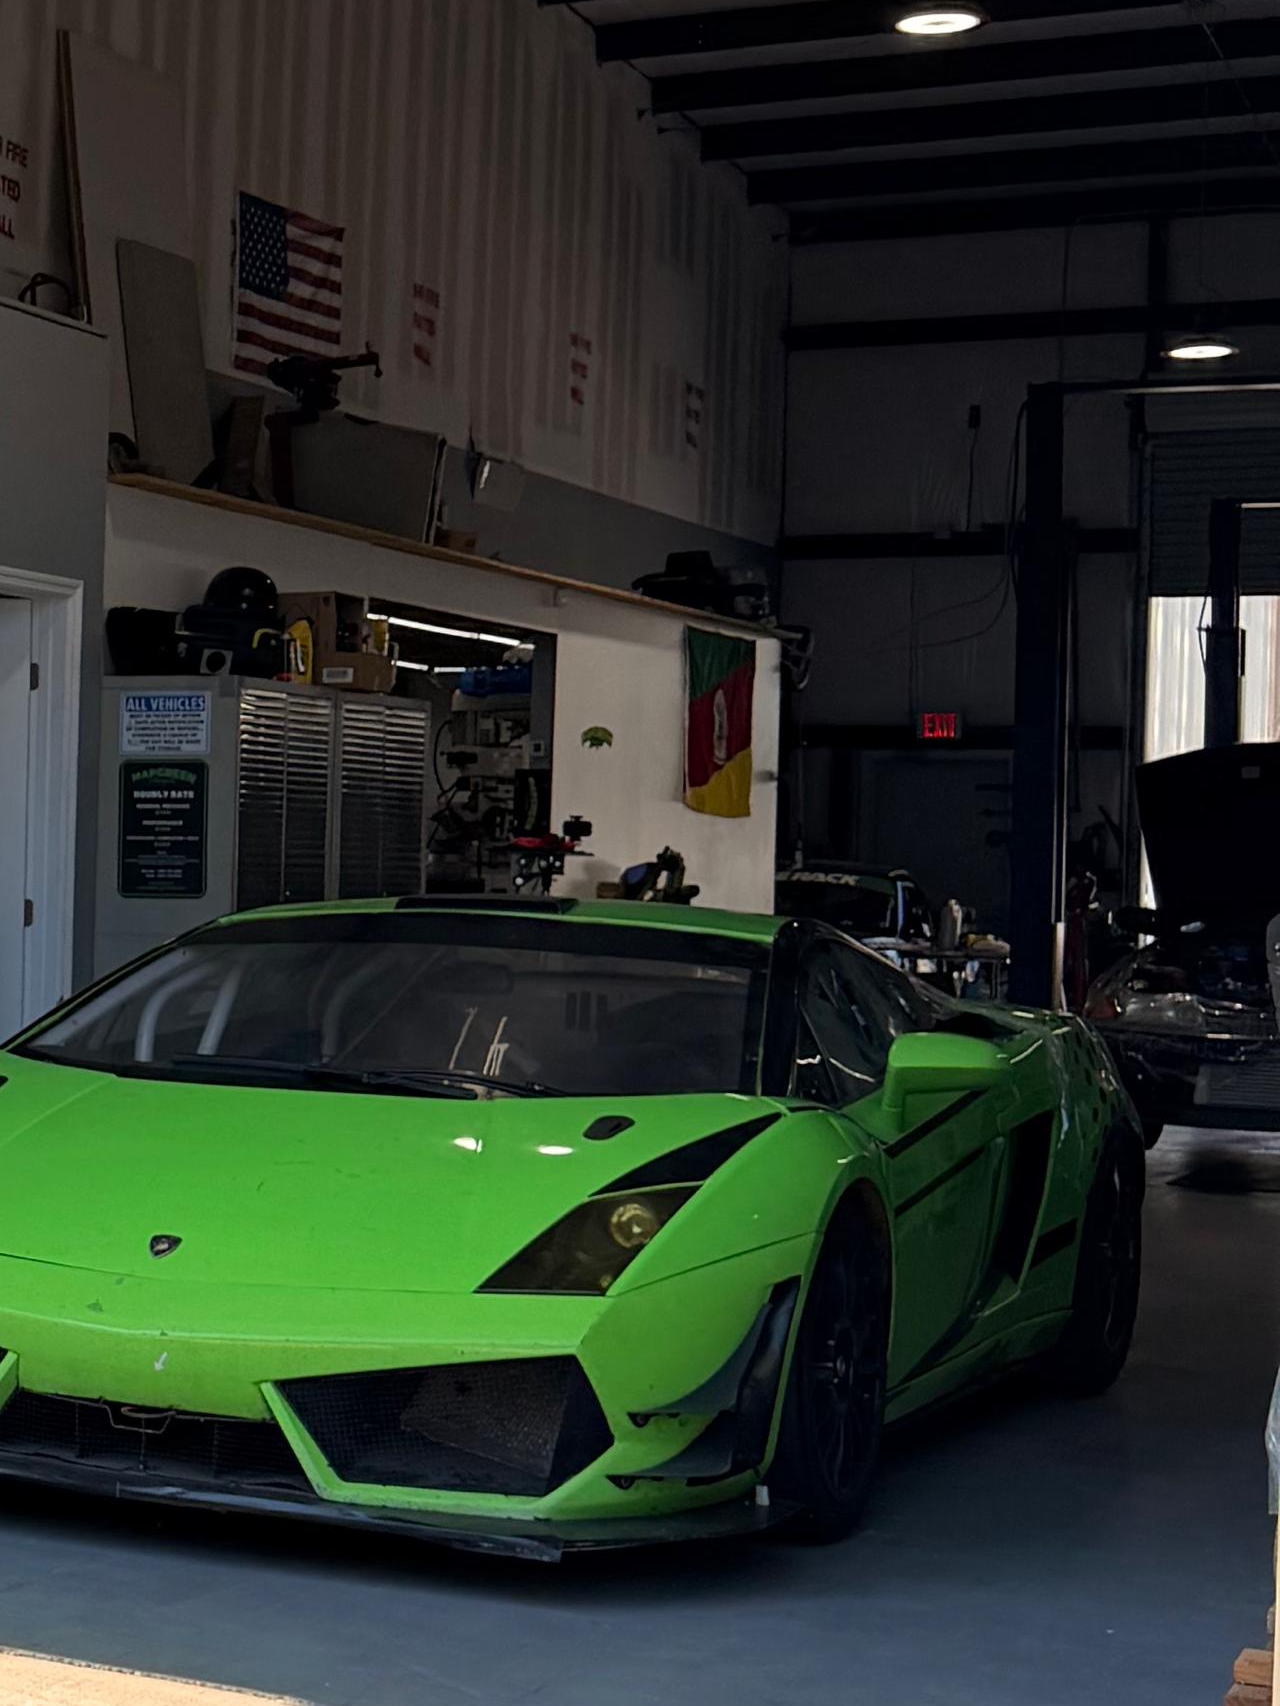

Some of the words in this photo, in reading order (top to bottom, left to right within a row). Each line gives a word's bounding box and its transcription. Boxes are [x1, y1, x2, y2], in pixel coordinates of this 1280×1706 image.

[126, 696, 148, 711] ALL
[150, 695, 204, 711] VEHICLES
[923, 713, 955, 738] EXIT
